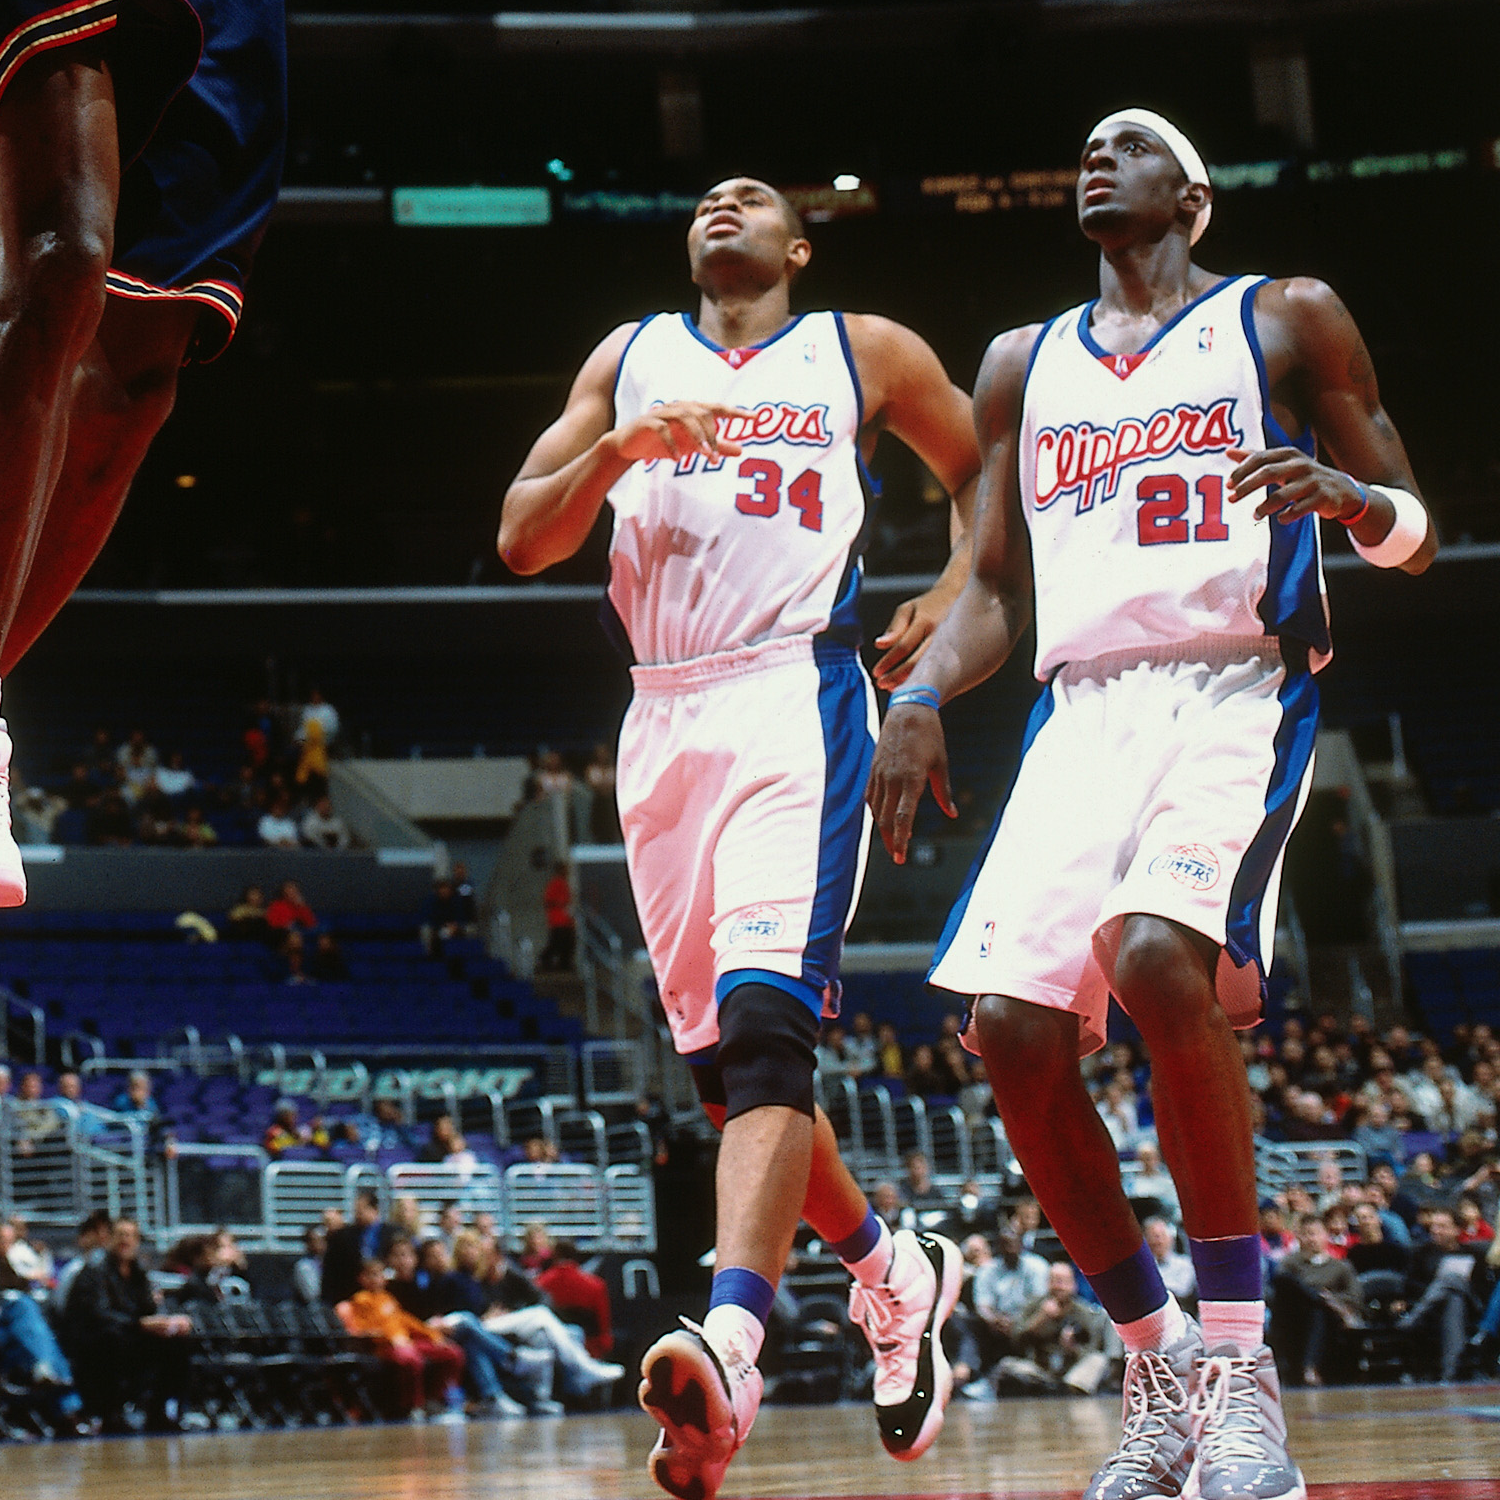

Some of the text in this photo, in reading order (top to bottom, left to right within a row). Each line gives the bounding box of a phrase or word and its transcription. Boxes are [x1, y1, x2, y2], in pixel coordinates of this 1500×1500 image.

[735, 457, 823, 533] 34
[1034, 398, 1244, 517] Clippers
[1137, 473, 1229, 546] 21
